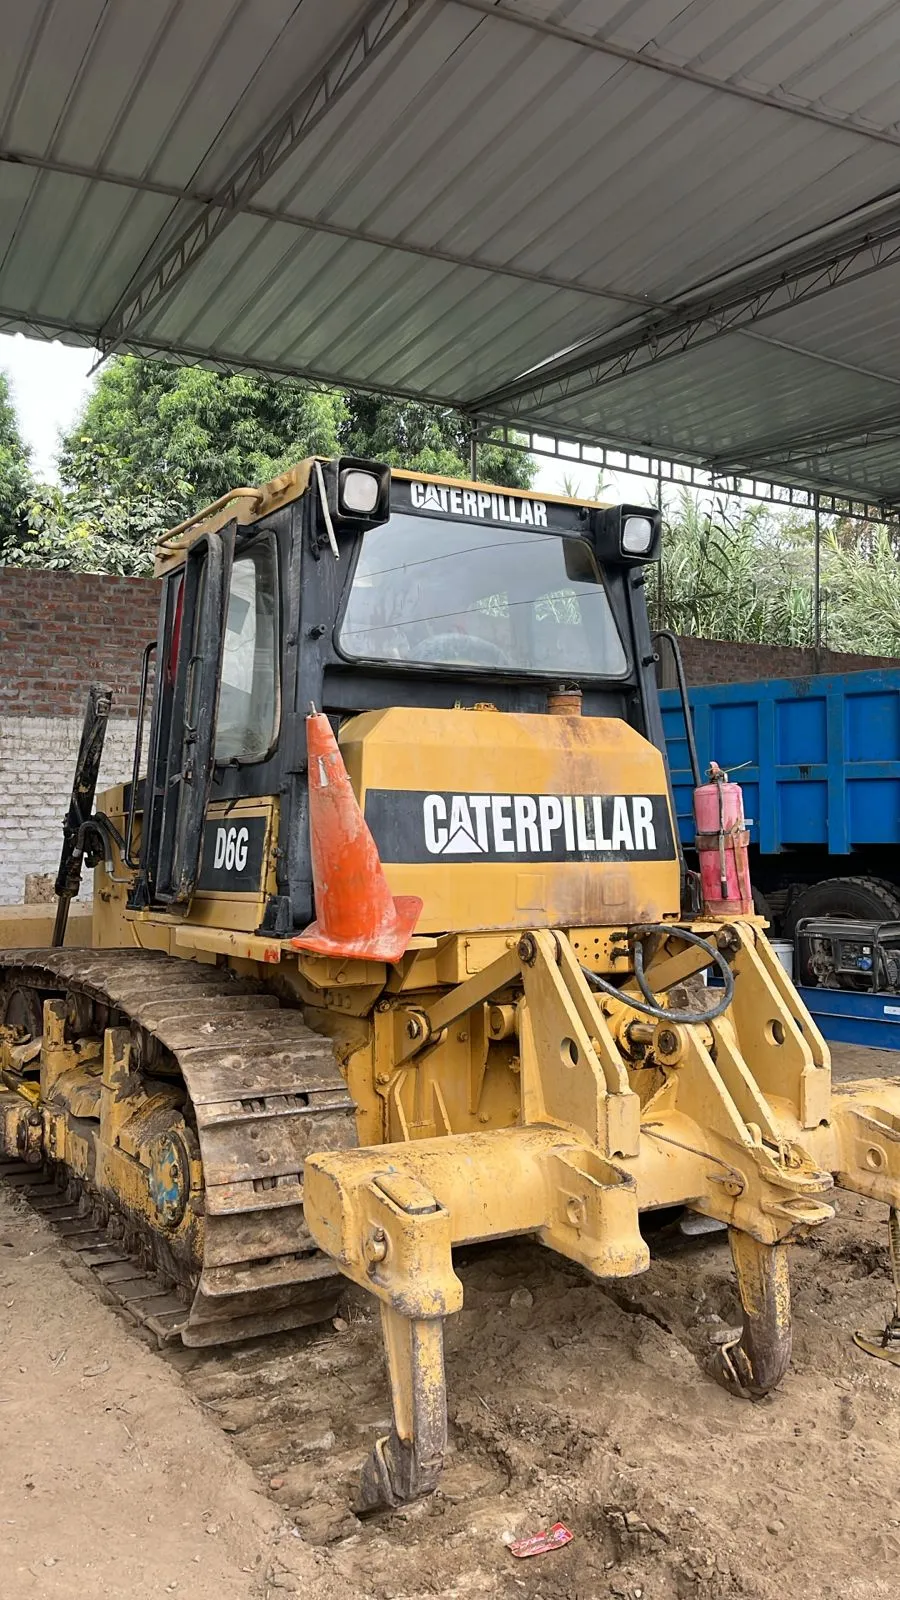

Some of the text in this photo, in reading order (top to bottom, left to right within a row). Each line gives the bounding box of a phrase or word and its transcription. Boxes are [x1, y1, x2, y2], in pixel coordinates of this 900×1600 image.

[410, 481, 548, 527] CATERPILLAR
[423, 794, 657, 854] CATERPILLAR
[213, 827, 249, 871] D6G
